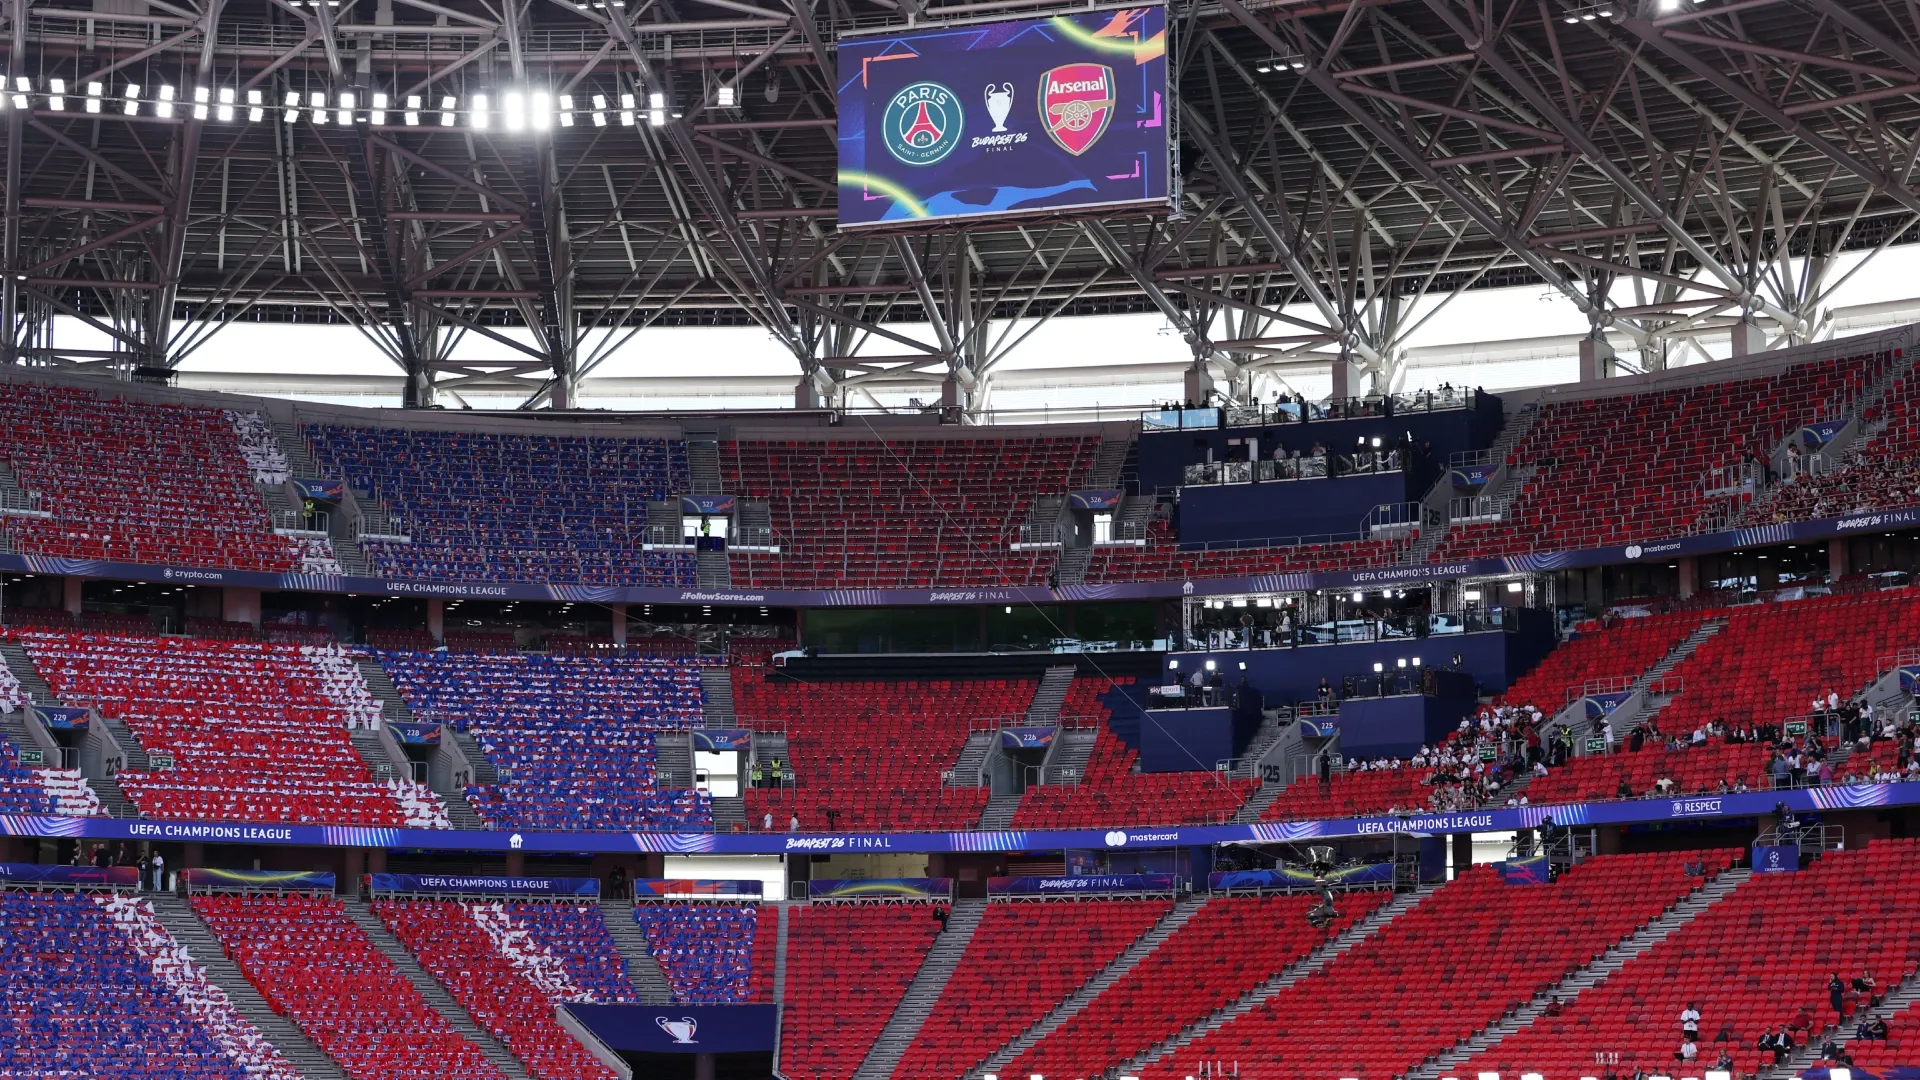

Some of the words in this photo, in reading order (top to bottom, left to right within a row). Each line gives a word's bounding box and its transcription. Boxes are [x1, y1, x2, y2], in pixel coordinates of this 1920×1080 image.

[1048, 76, 1104, 95] Arsenal
[896, 87, 949, 108] PARIS
[971, 134, 1016, 148] BUDAPEST
[1014, 132, 1028, 143] 26
[897, 143, 915, 157] SAINT
[920, 140, 949, 158] GERMAIN
[1470, 471, 1482, 479] 325
[1836, 517, 1870, 531] BUDAPEST
[1869, 516, 1881, 525] 26
[1884, 512, 1917, 524] FINAL
[1643, 542, 1681, 553] mastercard
[174, 570, 222, 580] crypto.com
[1352, 572, 1376, 582] UEFA
[1377, 567, 1430, 580] CHAMPIONS
[1433, 565, 1467, 575] LEAGUE
[386, 582, 411, 591] UEFA
[413, 583, 467, 594] CHAMPIONS
[470, 586, 507, 595] LEAGUE
[930, 592, 965, 602] BUDAPEST
[963, 592, 976, 601] 26
[979, 591, 1011, 600] FINAL
[1150, 687, 1161, 695] sky
[53, 713, 67, 721] 229
[1321, 722, 1334, 730] 225
[406, 729, 420, 737] 228
[715, 735, 729, 743] 227
[1684, 801, 1722, 812] RESPECT
[1357, 822, 1385, 833] UEFA
[1387, 817, 1449, 831] CHAMPIONS
[1451, 815, 1492, 828] LEAGUE
[129, 824, 162, 835] UEFA
[165, 825, 240, 838] CHAMPIONS
[243, 828, 292, 839] LEAGUE
[1130, 832, 1178, 842] mastercard
[785, 838, 831, 850] BUDAPEST
[829, 838, 845, 848] 26
[849, 837, 891, 848] FINAL
[420, 877, 447, 887] UEFA
[449, 878, 508, 889] CHAMPIONS
[511, 880, 550, 889] LEAGUE
[1039, 879, 1077, 890] BUDAPEST
[1075, 879, 1088, 888] 26
[1091, 878, 1124, 887] FINAL
